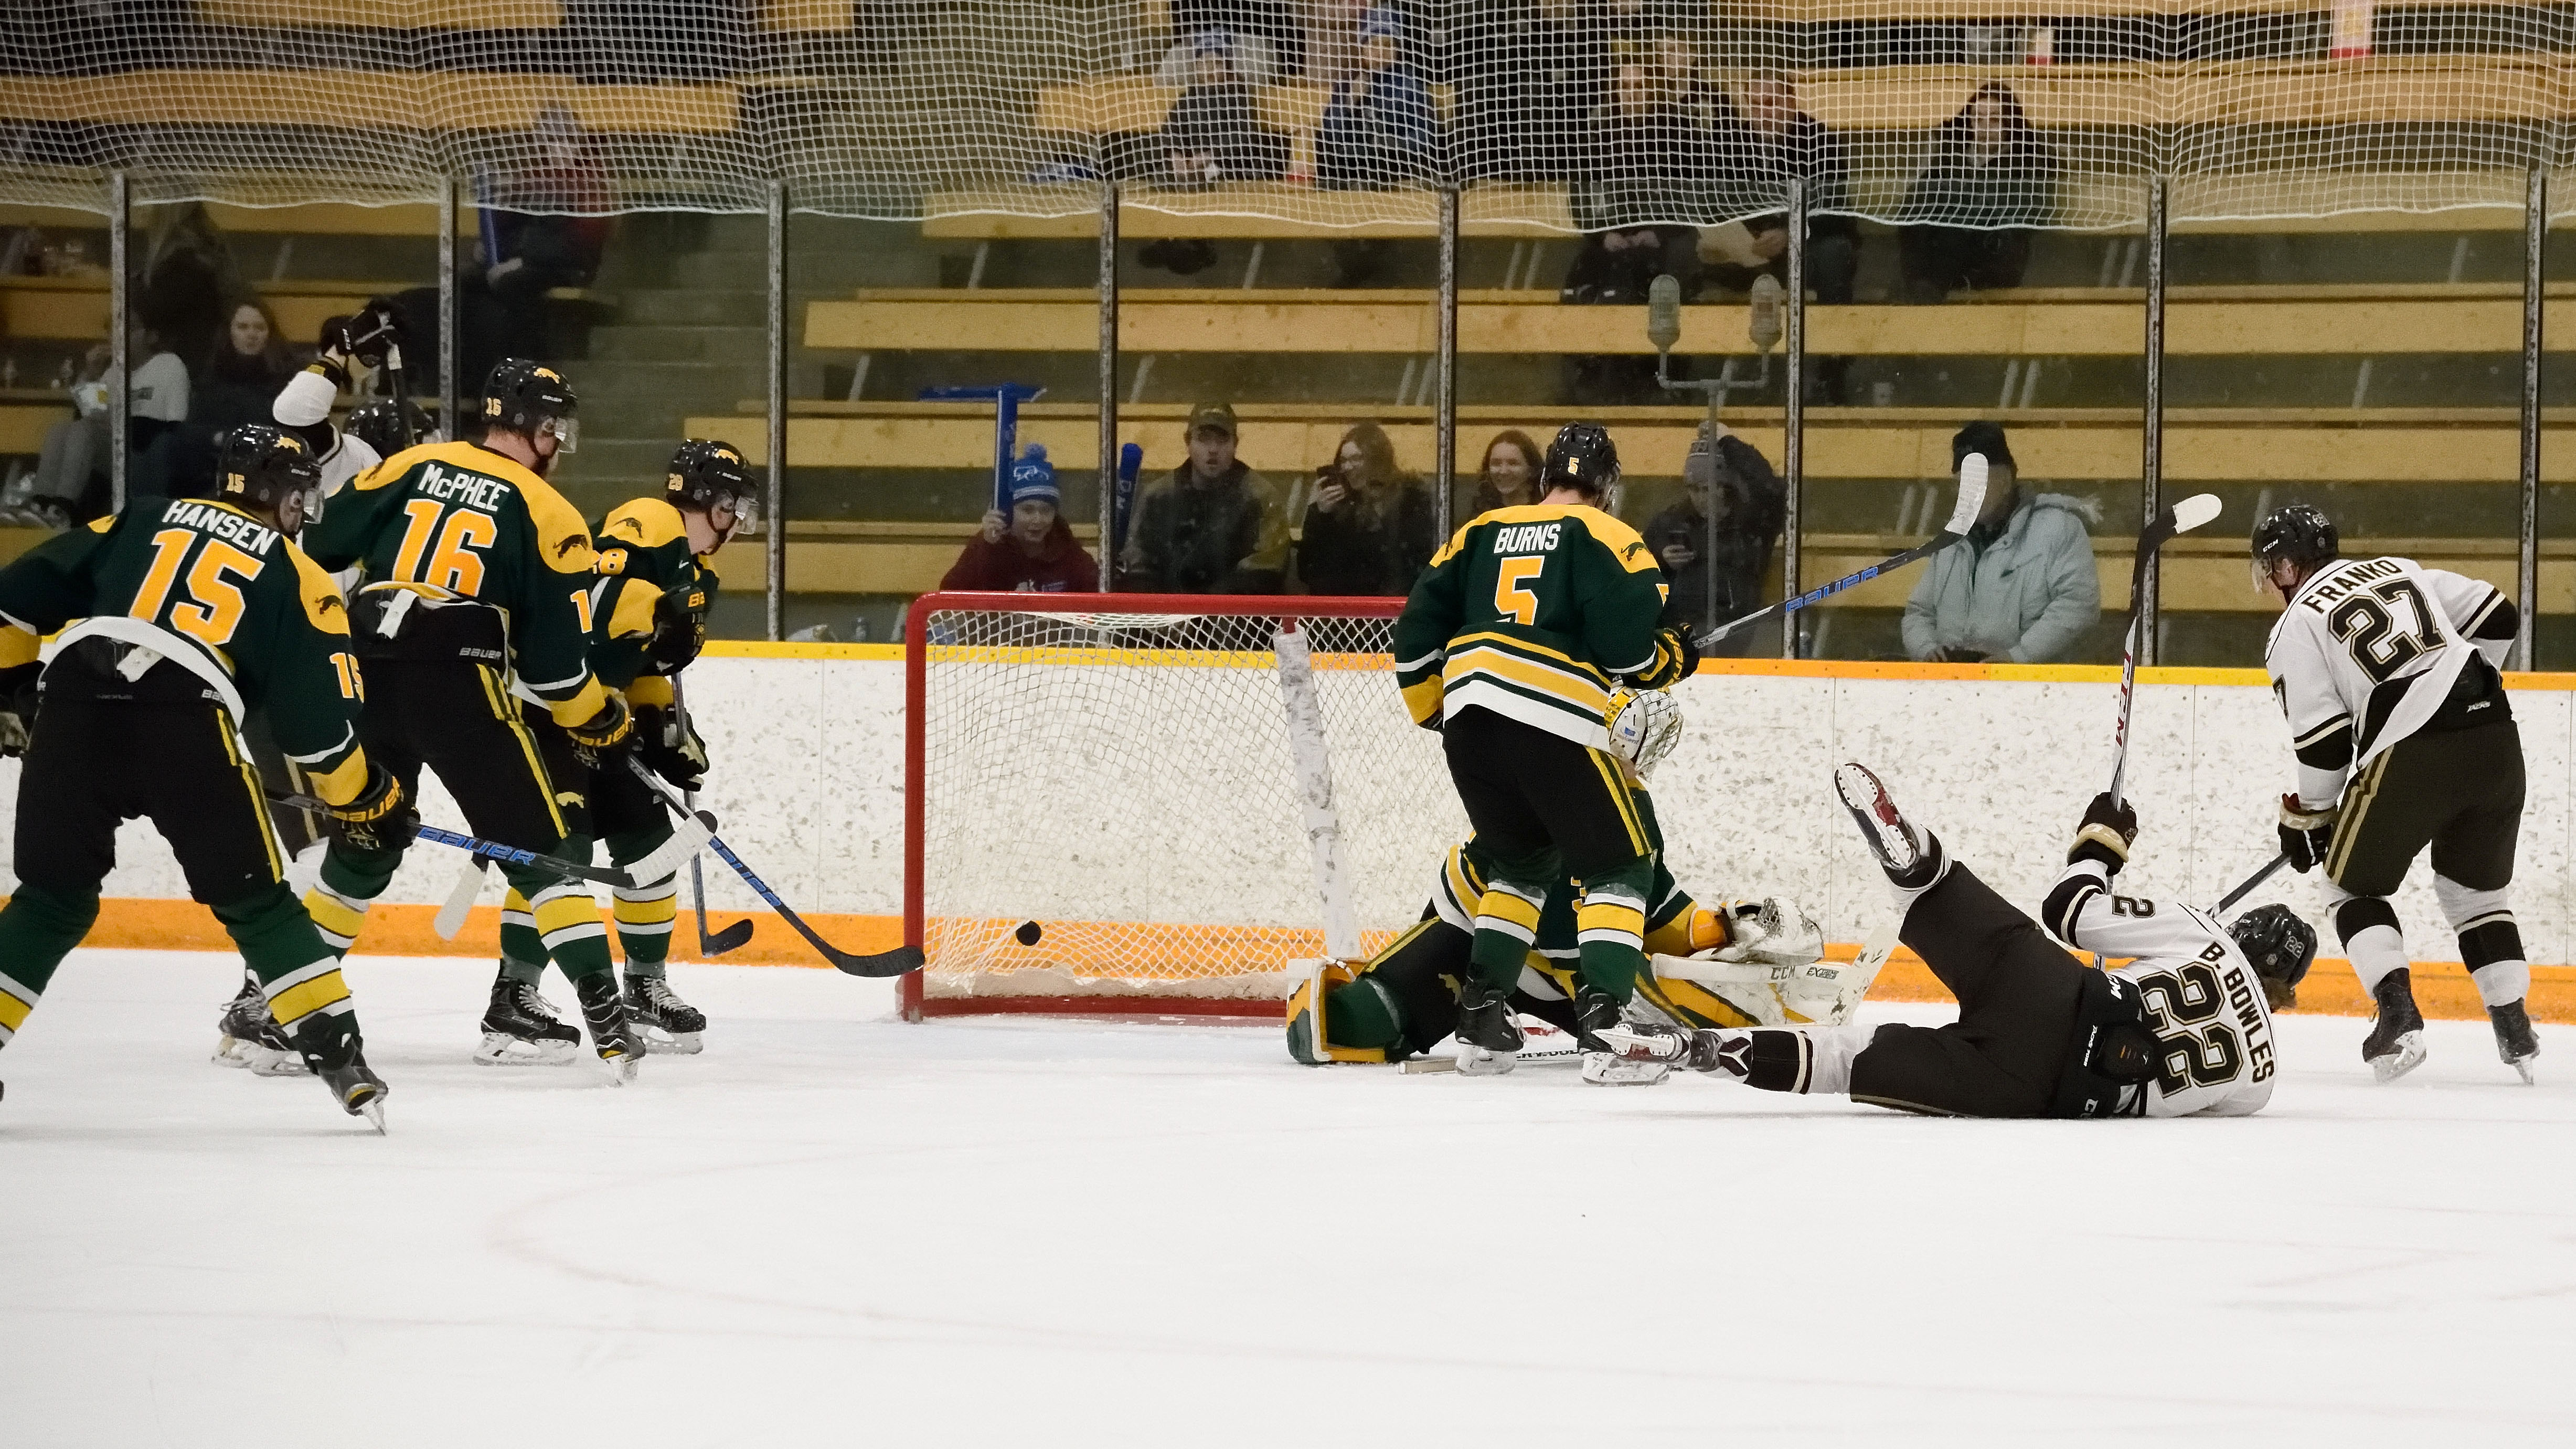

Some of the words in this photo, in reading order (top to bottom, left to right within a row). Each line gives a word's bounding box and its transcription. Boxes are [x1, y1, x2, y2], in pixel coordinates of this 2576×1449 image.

[486, 397, 502, 416] 16
[226, 473, 245, 493] 15
[1567, 457, 1579, 474] 5
[162, 500, 280, 555] HANSEN
[392, 499, 498, 598] 16
[1494, 524, 1561, 554] BURNS
[2262, 538, 2279, 553] CCM
[128, 528, 265, 645] 15
[1494, 555, 1545, 626] 5
[1785, 566, 1879, 612] BAUER
[2301, 560, 2402, 614] FRANKO
[459, 647, 502, 660] BAUER
[2328, 577, 2447, 686] 27
[418, 827, 536, 866] BAUER
[709, 836, 782, 907] BAUER
[2284, 936, 2305, 959] 22
[1770, 965, 1796, 980] CCM
[2136, 960, 2244, 1099] 22
[2199, 942, 2226, 970] B.
[2223, 966, 2275, 1084] BOWLES
